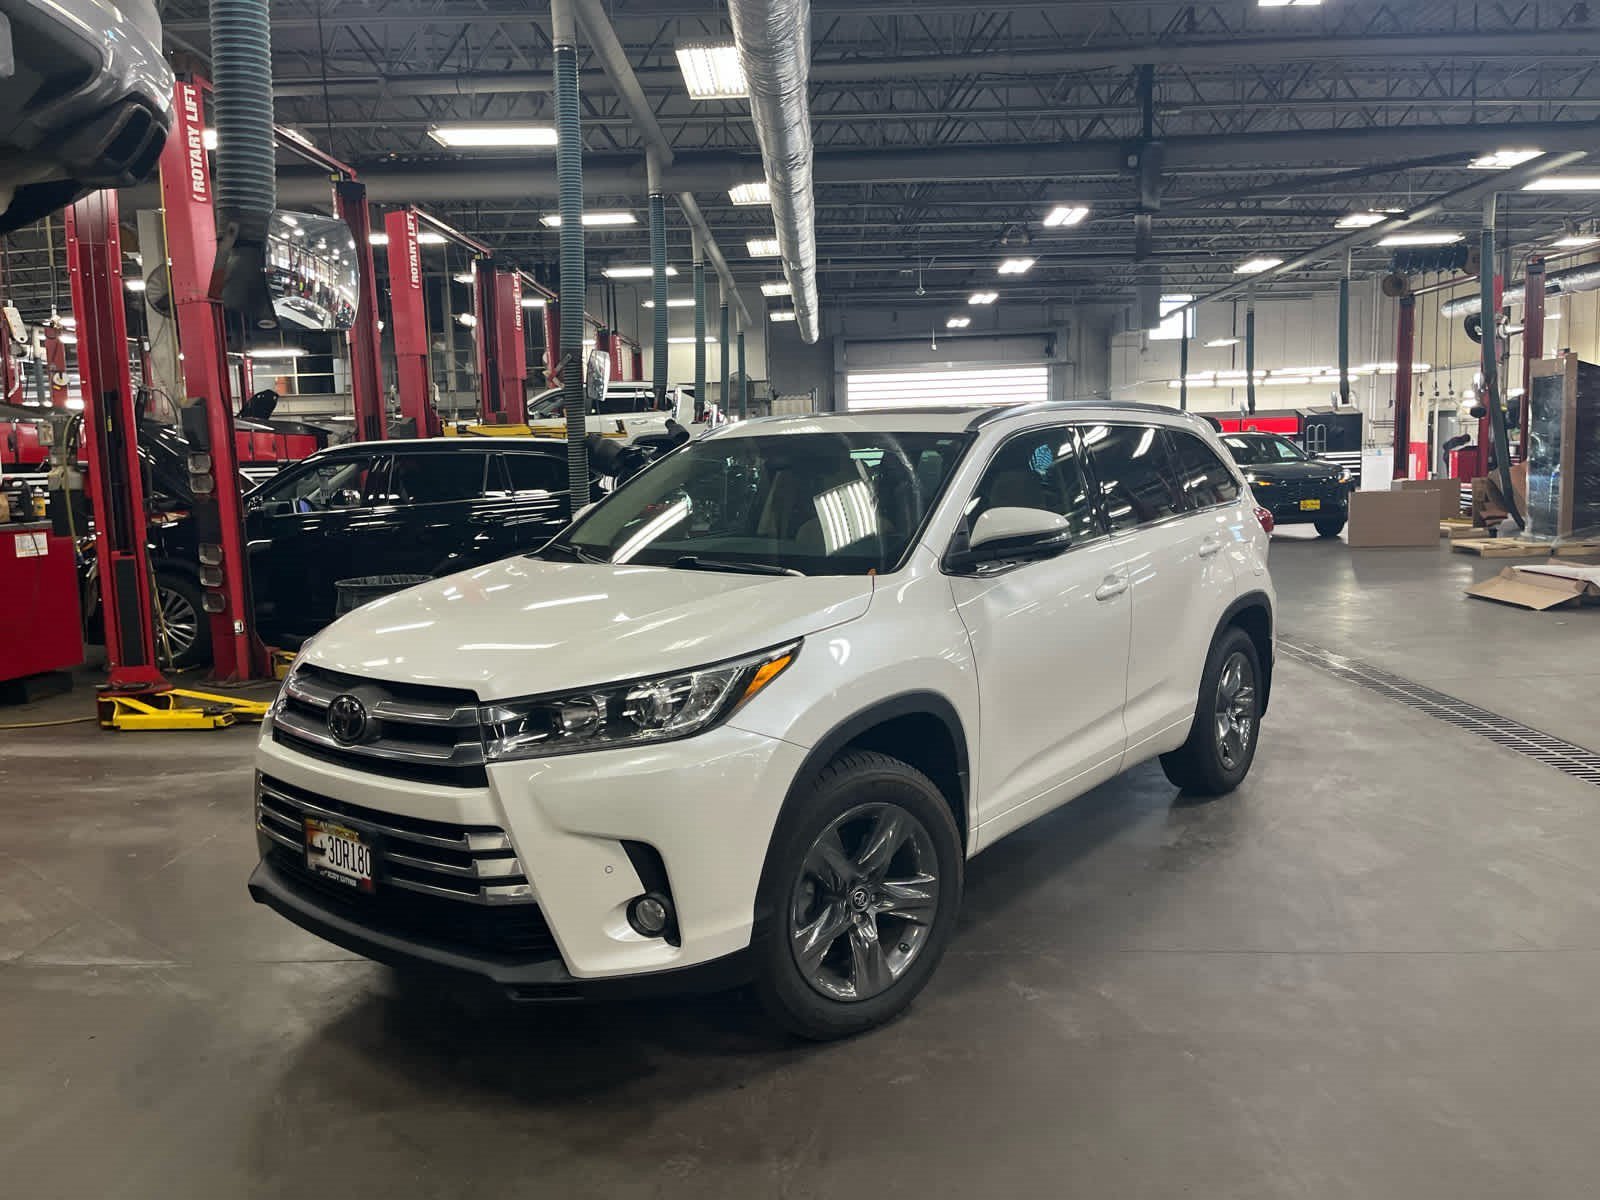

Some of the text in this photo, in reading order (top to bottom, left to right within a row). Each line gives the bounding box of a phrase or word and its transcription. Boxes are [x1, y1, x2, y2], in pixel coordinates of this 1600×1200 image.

[183, 85, 206, 193] ROTARY LIFT
[406, 212, 419, 283] ROTARY LIFT
[327, 835, 373, 877] 3DR180
